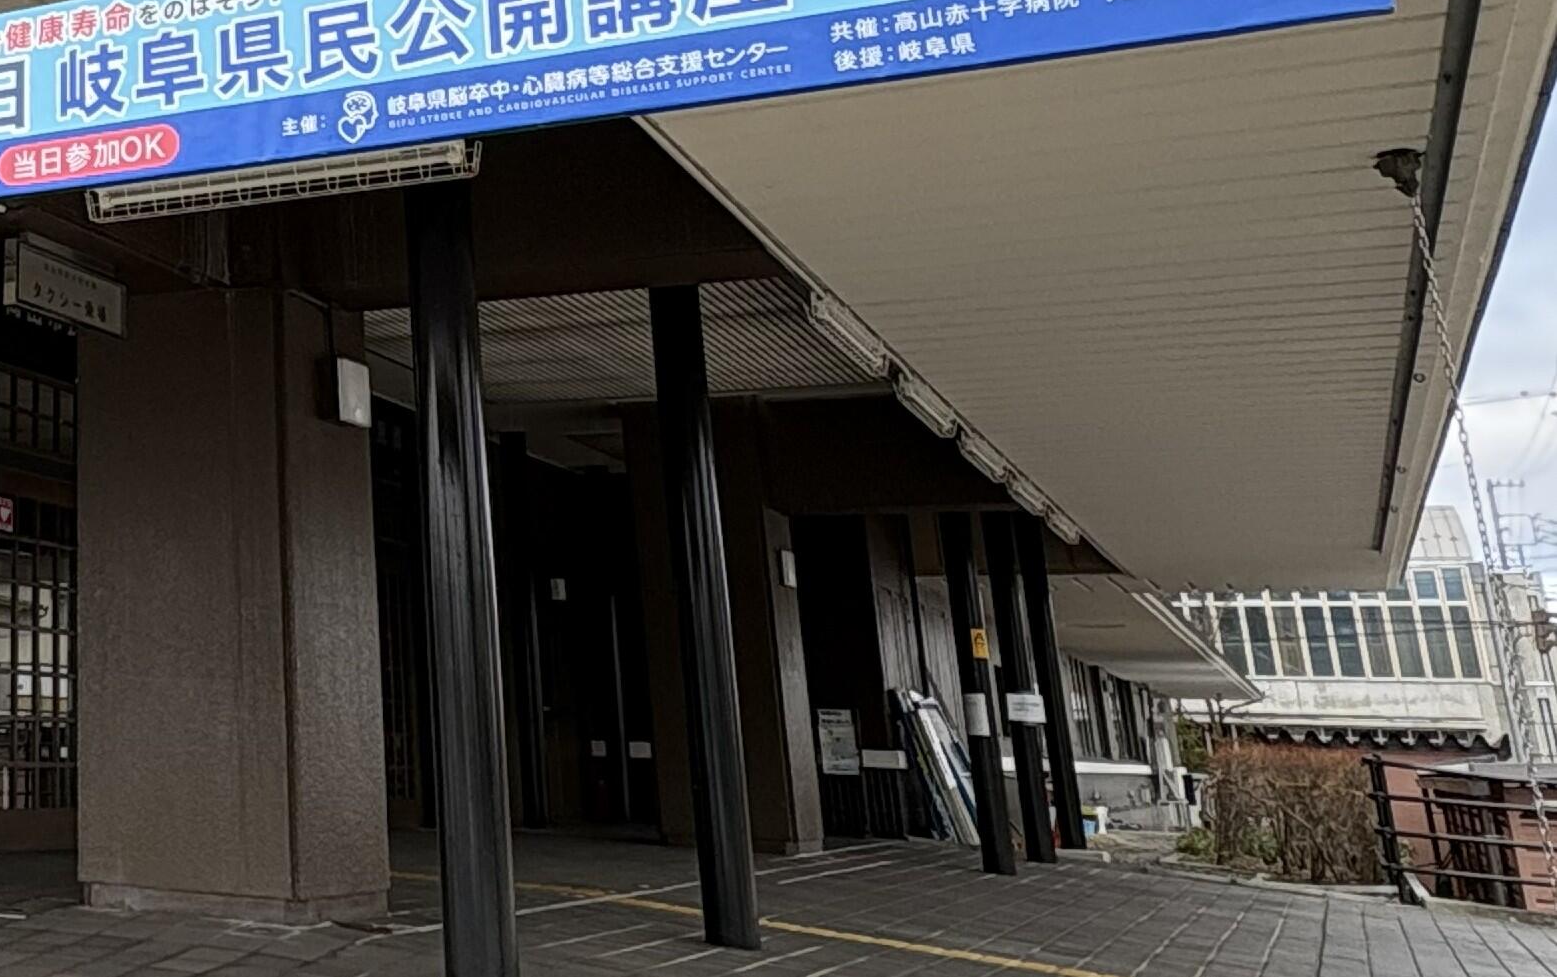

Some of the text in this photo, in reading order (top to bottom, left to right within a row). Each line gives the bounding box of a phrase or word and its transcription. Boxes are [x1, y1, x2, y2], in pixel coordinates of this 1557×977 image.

[421, 111, 463, 124] STROKE
[468, 106, 493, 118] AND
[498, 89, 606, 112] CARDIOVASCULAR
[612, 80, 671, 97] DISEASES
[676, 71, 733, 88] SUPPORT
[741, 64, 792, 79] CENTER
[14, 132, 166, 179] 当日参加OK
